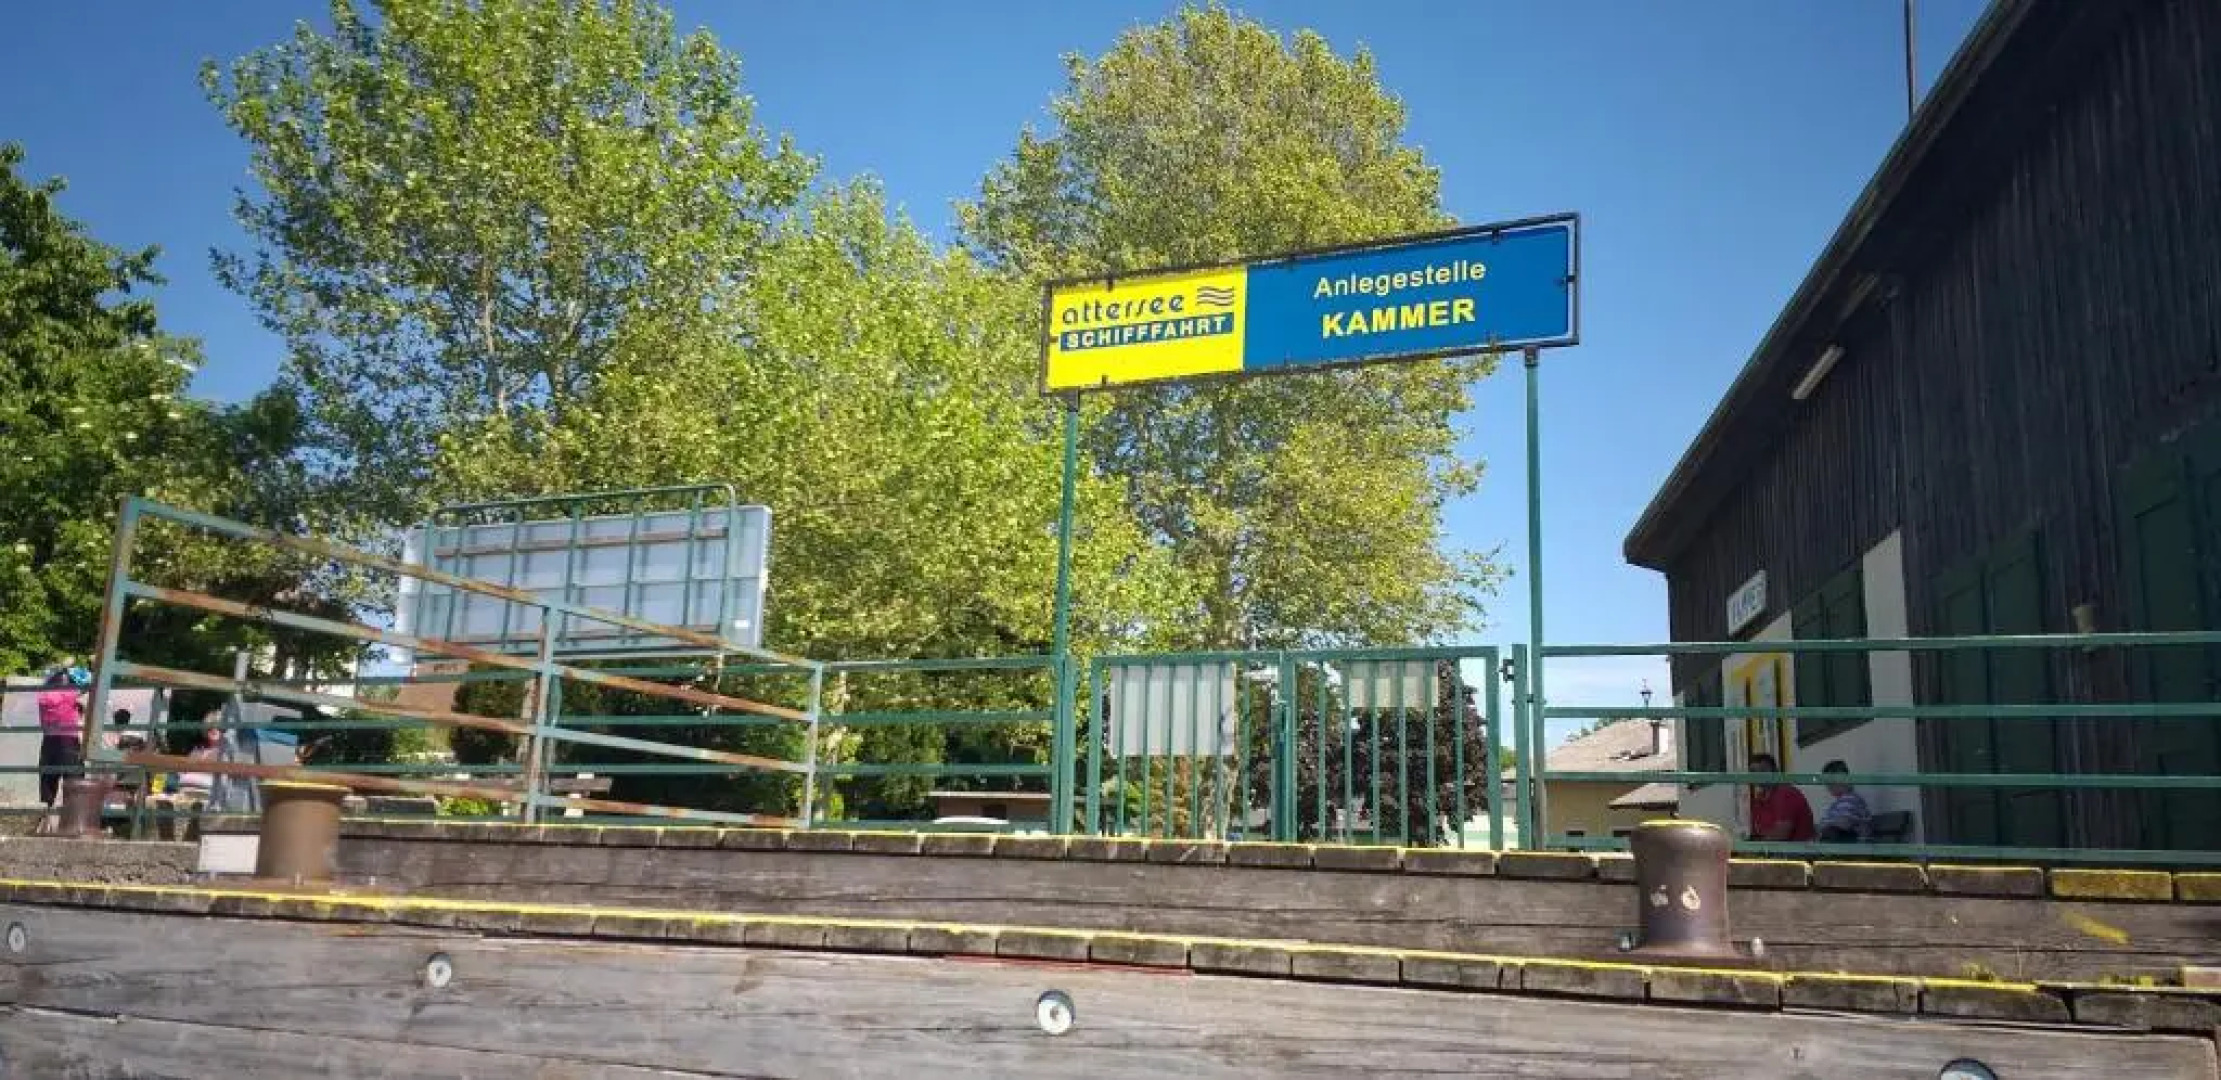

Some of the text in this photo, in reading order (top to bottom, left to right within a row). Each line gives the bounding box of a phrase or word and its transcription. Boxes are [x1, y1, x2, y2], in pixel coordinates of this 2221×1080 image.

[1313, 259, 1487, 298] Anlegestelle
[1062, 294, 1185, 324] attersee
[1322, 298, 1476, 339] KAMMER
[1066, 316, 1227, 348] SCHIFFFAHRT
